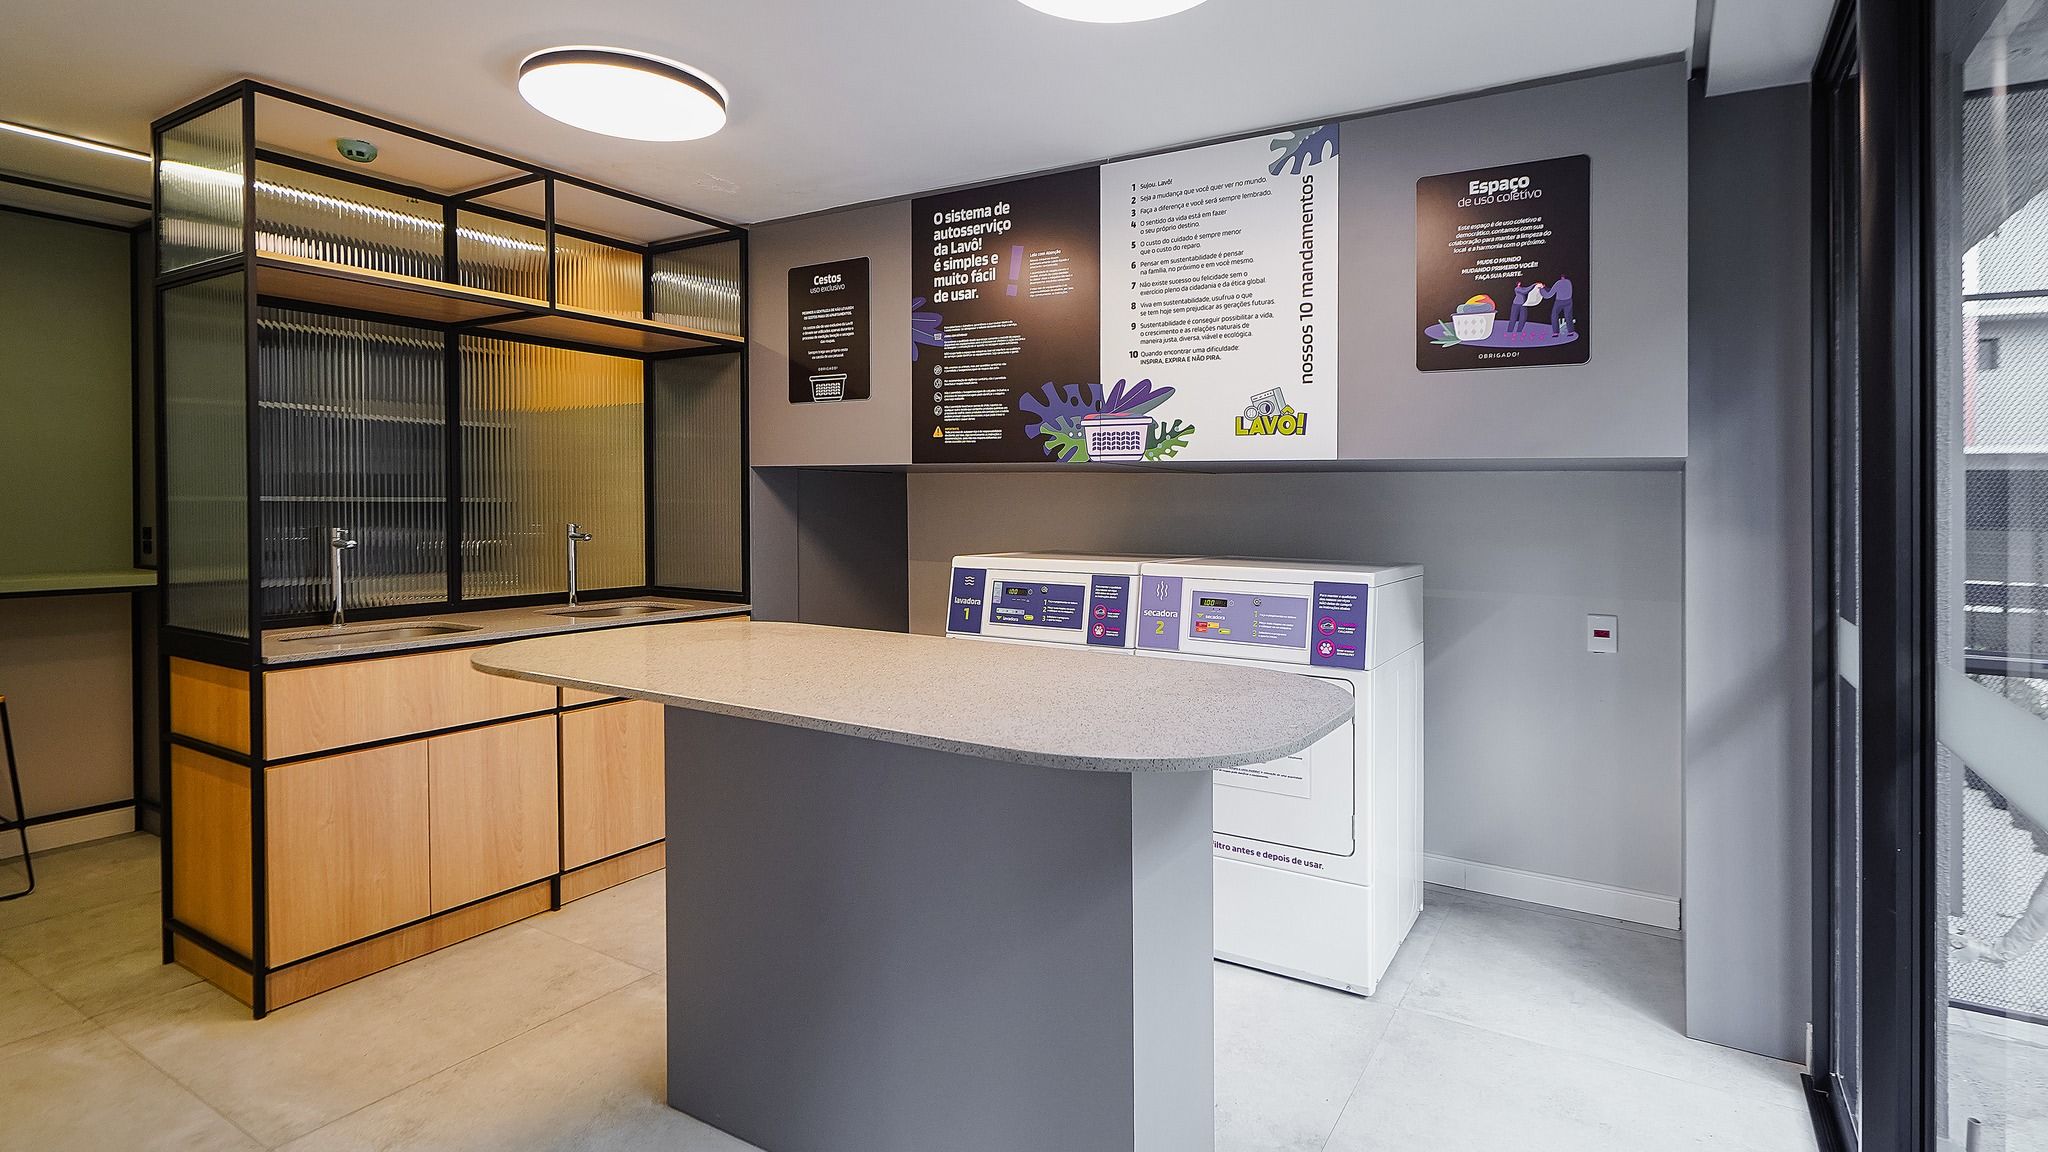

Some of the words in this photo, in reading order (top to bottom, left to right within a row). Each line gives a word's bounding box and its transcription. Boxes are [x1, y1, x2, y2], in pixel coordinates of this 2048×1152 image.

[1140, 182, 1157, 190] Sujou.
[1157, 190, 1183, 199] mudança
[1183, 188, 1195, 196] que
[1195, 185, 1209, 193] você
[1469, 177, 1530, 195] Espaço
[1130, 209, 1136, 217] 3
[1158, 203, 1185, 212] diferença
[1205, 197, 1218, 205] será
[1218, 195, 1241, 203] sempre
[1242, 190, 1272, 199] lembrado.
[1458, 197, 1472, 207] de
[1474, 196, 1495, 205] uso
[1496, 188, 1542, 202] coletivo
[934, 212, 943, 225] O
[945, 207, 991, 223] sistema
[994, 202, 1010, 216] de
[1145, 218, 1167, 226] sentido
[1188, 212, 1201, 220] está
[934, 220, 1011, 240] autosserviço
[1156, 225, 1177, 233] próprio
[1299, 174, 1314, 297] mandamentos
[934, 243, 948, 256] da
[951, 238, 982, 254] Lavô!
[1130, 241, 1136, 249] 5
[1170, 235, 1194, 243] cuidado
[1199, 232, 1221, 240] sempre
[934, 258, 941, 272] é
[943, 254, 989, 271] simples
[991, 254, 998, 264] e
[1130, 261, 1136, 269] 6
[1170, 253, 1218, 264] sustentabilidade
[1223, 250, 1244, 258] pensar
[814, 274, 841, 285] Cestos
[934, 272, 969, 287] muito
[971, 268, 995, 283] fácil
[1201, 273, 1229, 281] felicidade
[820, 284, 845, 292] exclusivo
[934, 290, 949, 303] de
[951, 289, 979, 301] usar.
[1130, 302, 1136, 310] 8
[1163, 296, 1211, 306] sustentabilidade,
[1211, 294, 1235, 302] usufrua
[1186, 305, 1215, 313] prejudicar
[1223, 301, 1251, 310] gerações
[1300, 302, 1313, 321] 10
[1140, 320, 1186, 329] Sustentabilidade
[1221, 314, 1254, 323] possibilitar
[1191, 325, 1216, 333] relações
[1141, 350, 1163, 358] Quando
[1191, 354, 1205, 362] NÃO
[1302, 325, 1313, 384] nossos
[1235, 405, 1308, 436] LAVÔ!
[954, 596, 981, 607] lavadora
[963, 607, 970, 620] 1
[1143, 608, 1178, 618] secadora
[1155, 620, 1165, 635] 2
[1232, 846, 1255, 856] antes
[1262, 851, 1290, 863] depois
[1291, 857, 1302, 865] de
[1303, 860, 1324, 870] usar.
